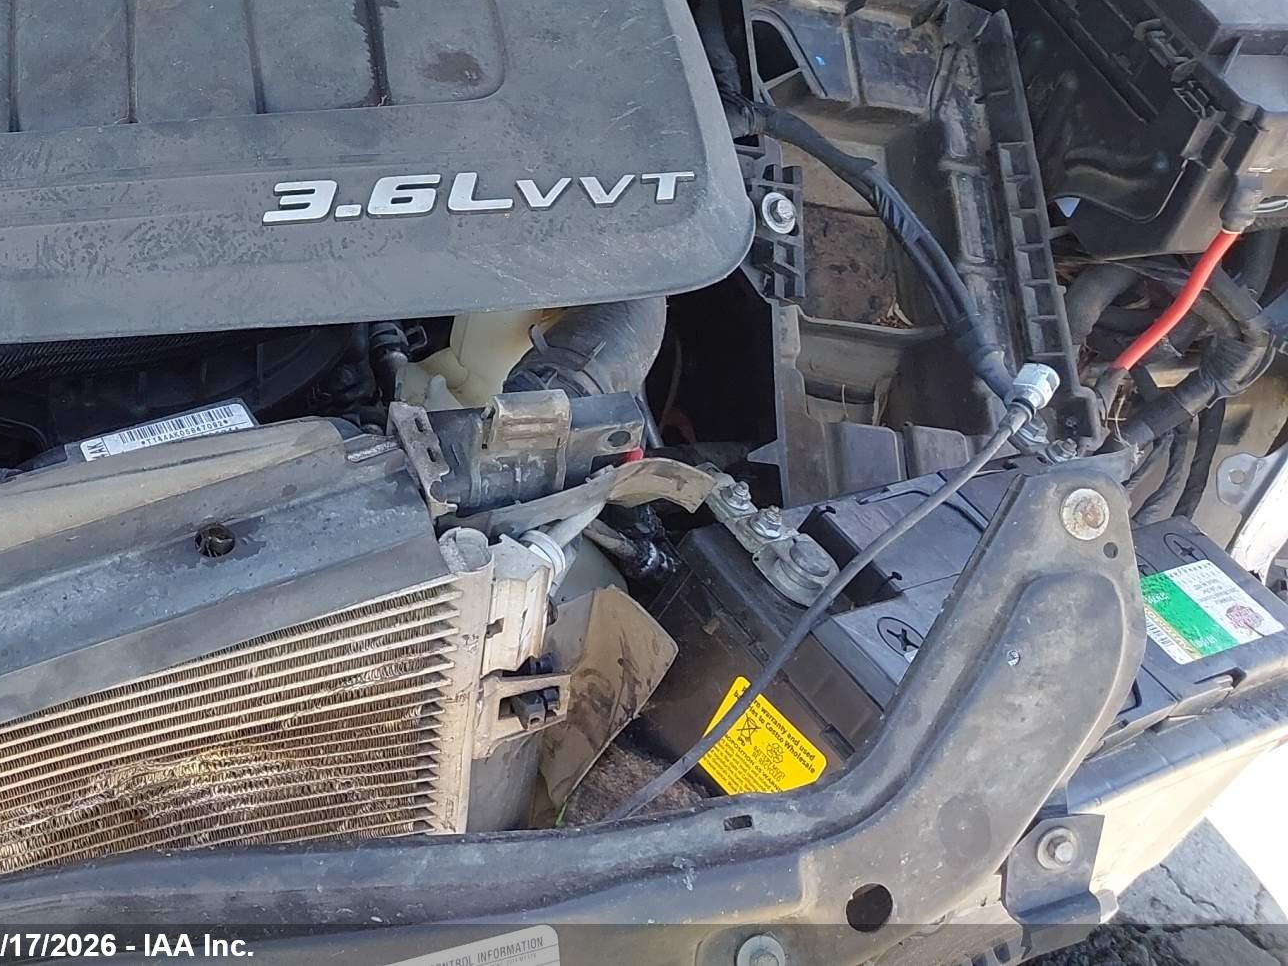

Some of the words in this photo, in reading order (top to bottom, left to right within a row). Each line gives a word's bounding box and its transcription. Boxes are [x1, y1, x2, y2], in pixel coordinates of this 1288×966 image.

[758, 716, 766, 725] to
[765, 722, 785, 744] Costco
[784, 740, 816, 774] Wholesale
[761, 708, 787, 736] warranty
[787, 732, 801, 747] and
[799, 745, 816, 761] used
[477, 936, 545, 964] INFORMATION
